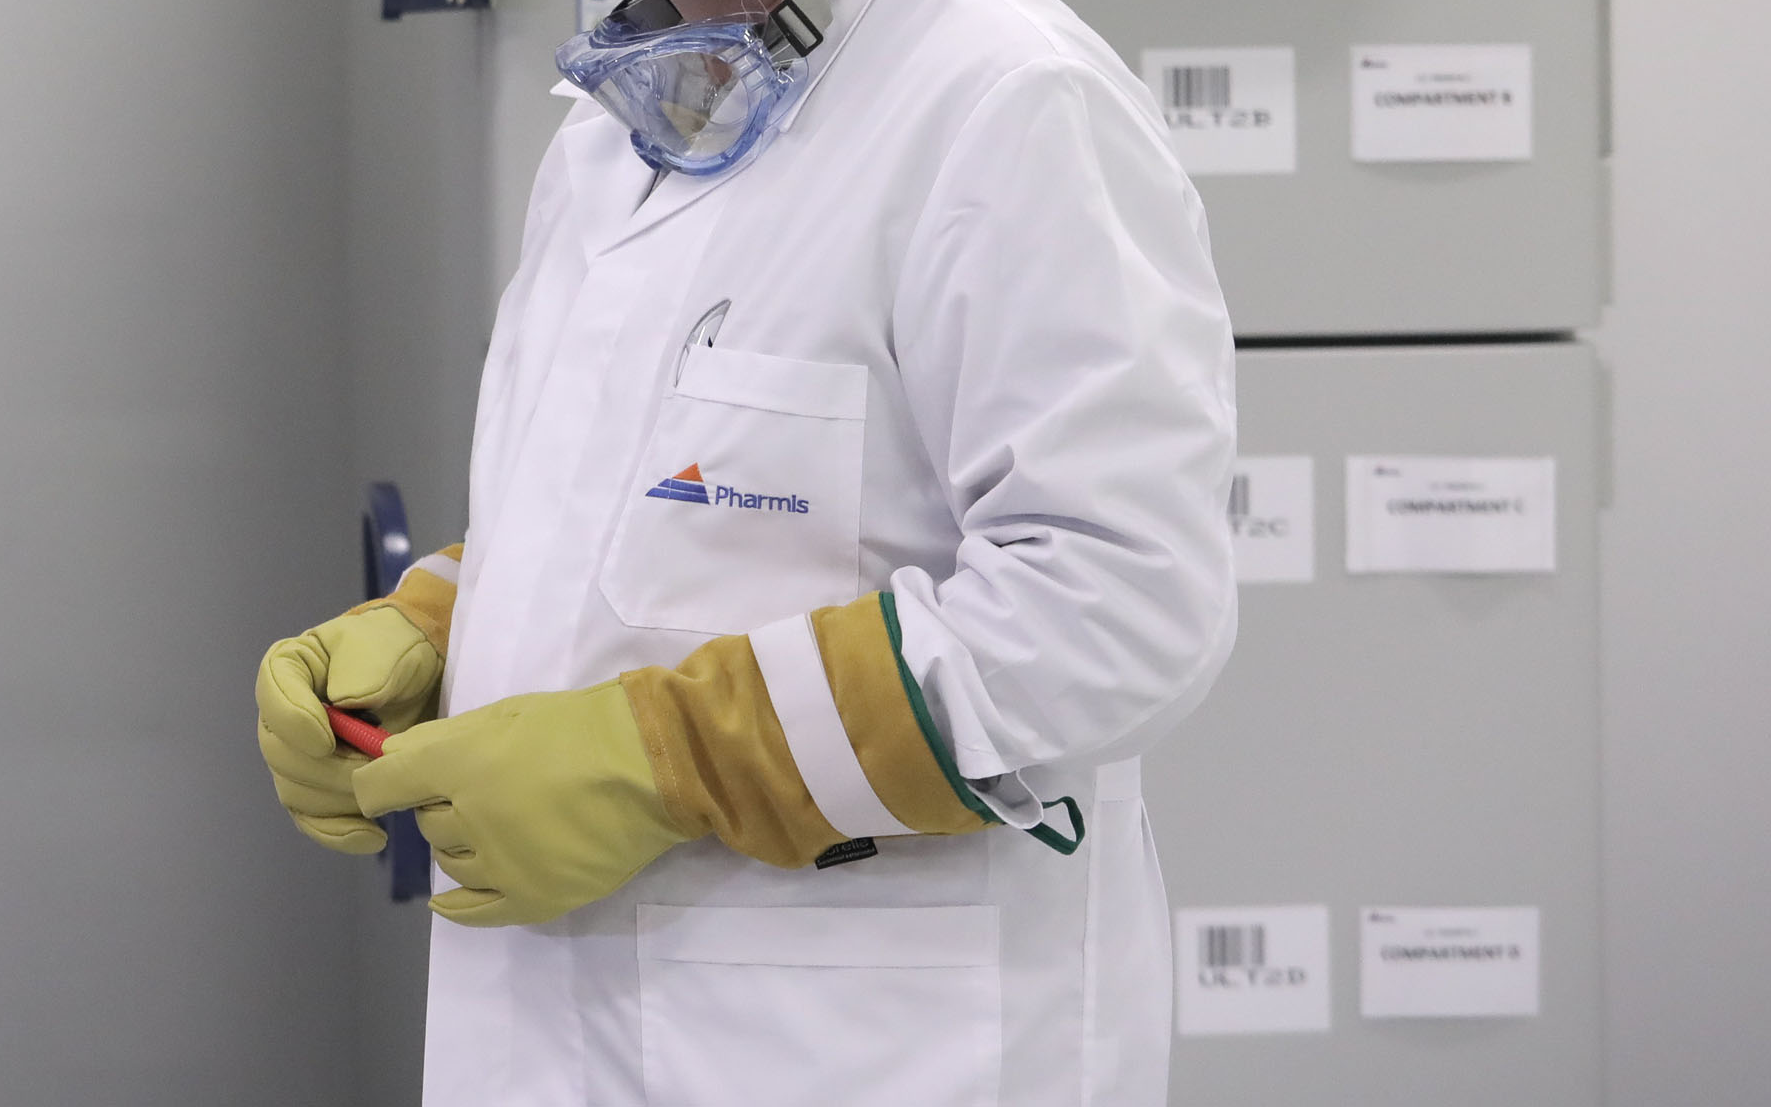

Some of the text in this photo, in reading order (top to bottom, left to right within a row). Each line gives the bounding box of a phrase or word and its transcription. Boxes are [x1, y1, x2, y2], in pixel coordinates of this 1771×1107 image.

[1374, 91, 1497, 107] COMPARTMENT
[715, 486, 809, 514] Pharmis
[1230, 518, 1288, 538] T2C
